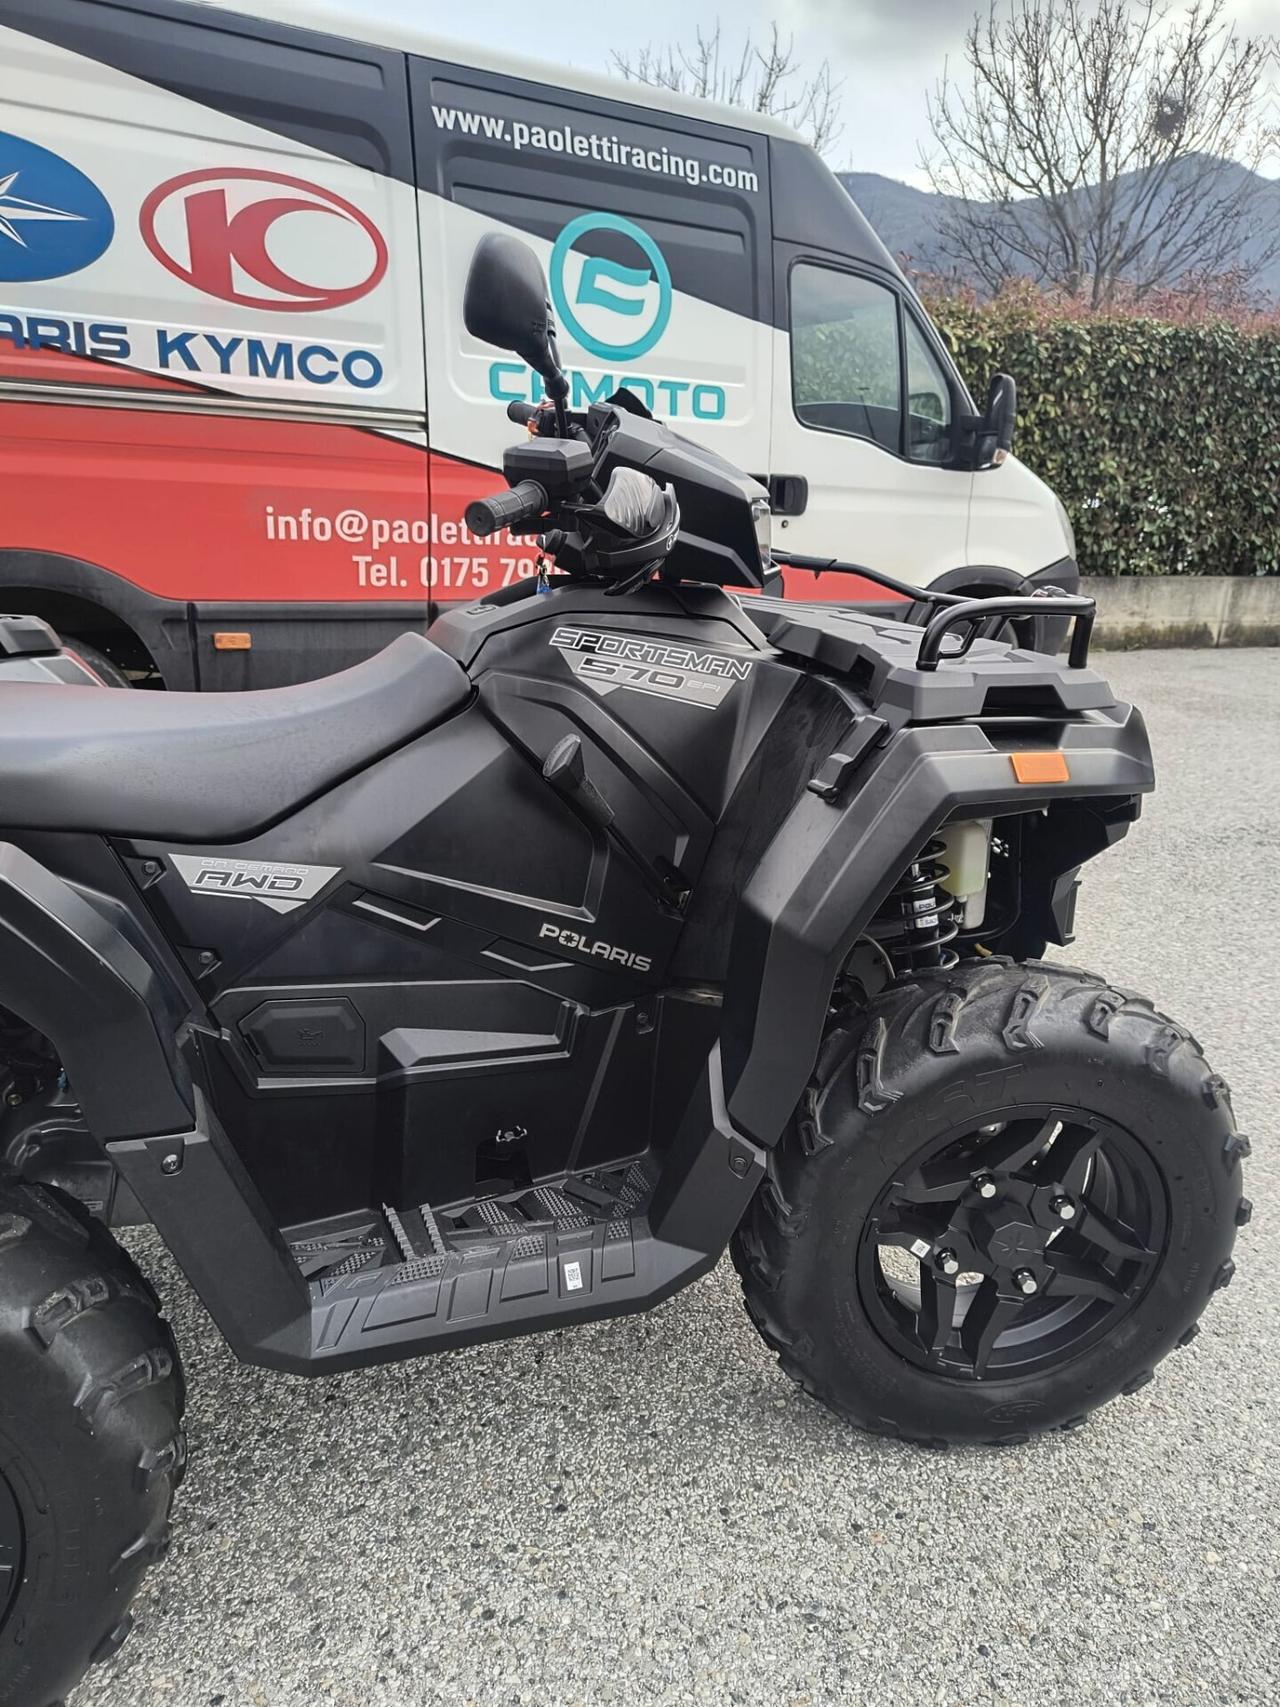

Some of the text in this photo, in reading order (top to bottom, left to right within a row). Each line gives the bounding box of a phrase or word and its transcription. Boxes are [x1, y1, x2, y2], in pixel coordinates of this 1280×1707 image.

[431, 105, 759, 192] www.paolettiracing.com
[156, 329, 383, 389] KYMCO
[265, 506, 537, 549] info@paolet
[352, 555, 408, 588] Tel.
[420, 556, 489, 588] 0175
[549, 627, 752, 681] SPORTSMAN
[578, 657, 685, 690] 570
[193, 868, 305, 893] AWD
[538, 923, 653, 972] POLARIS
